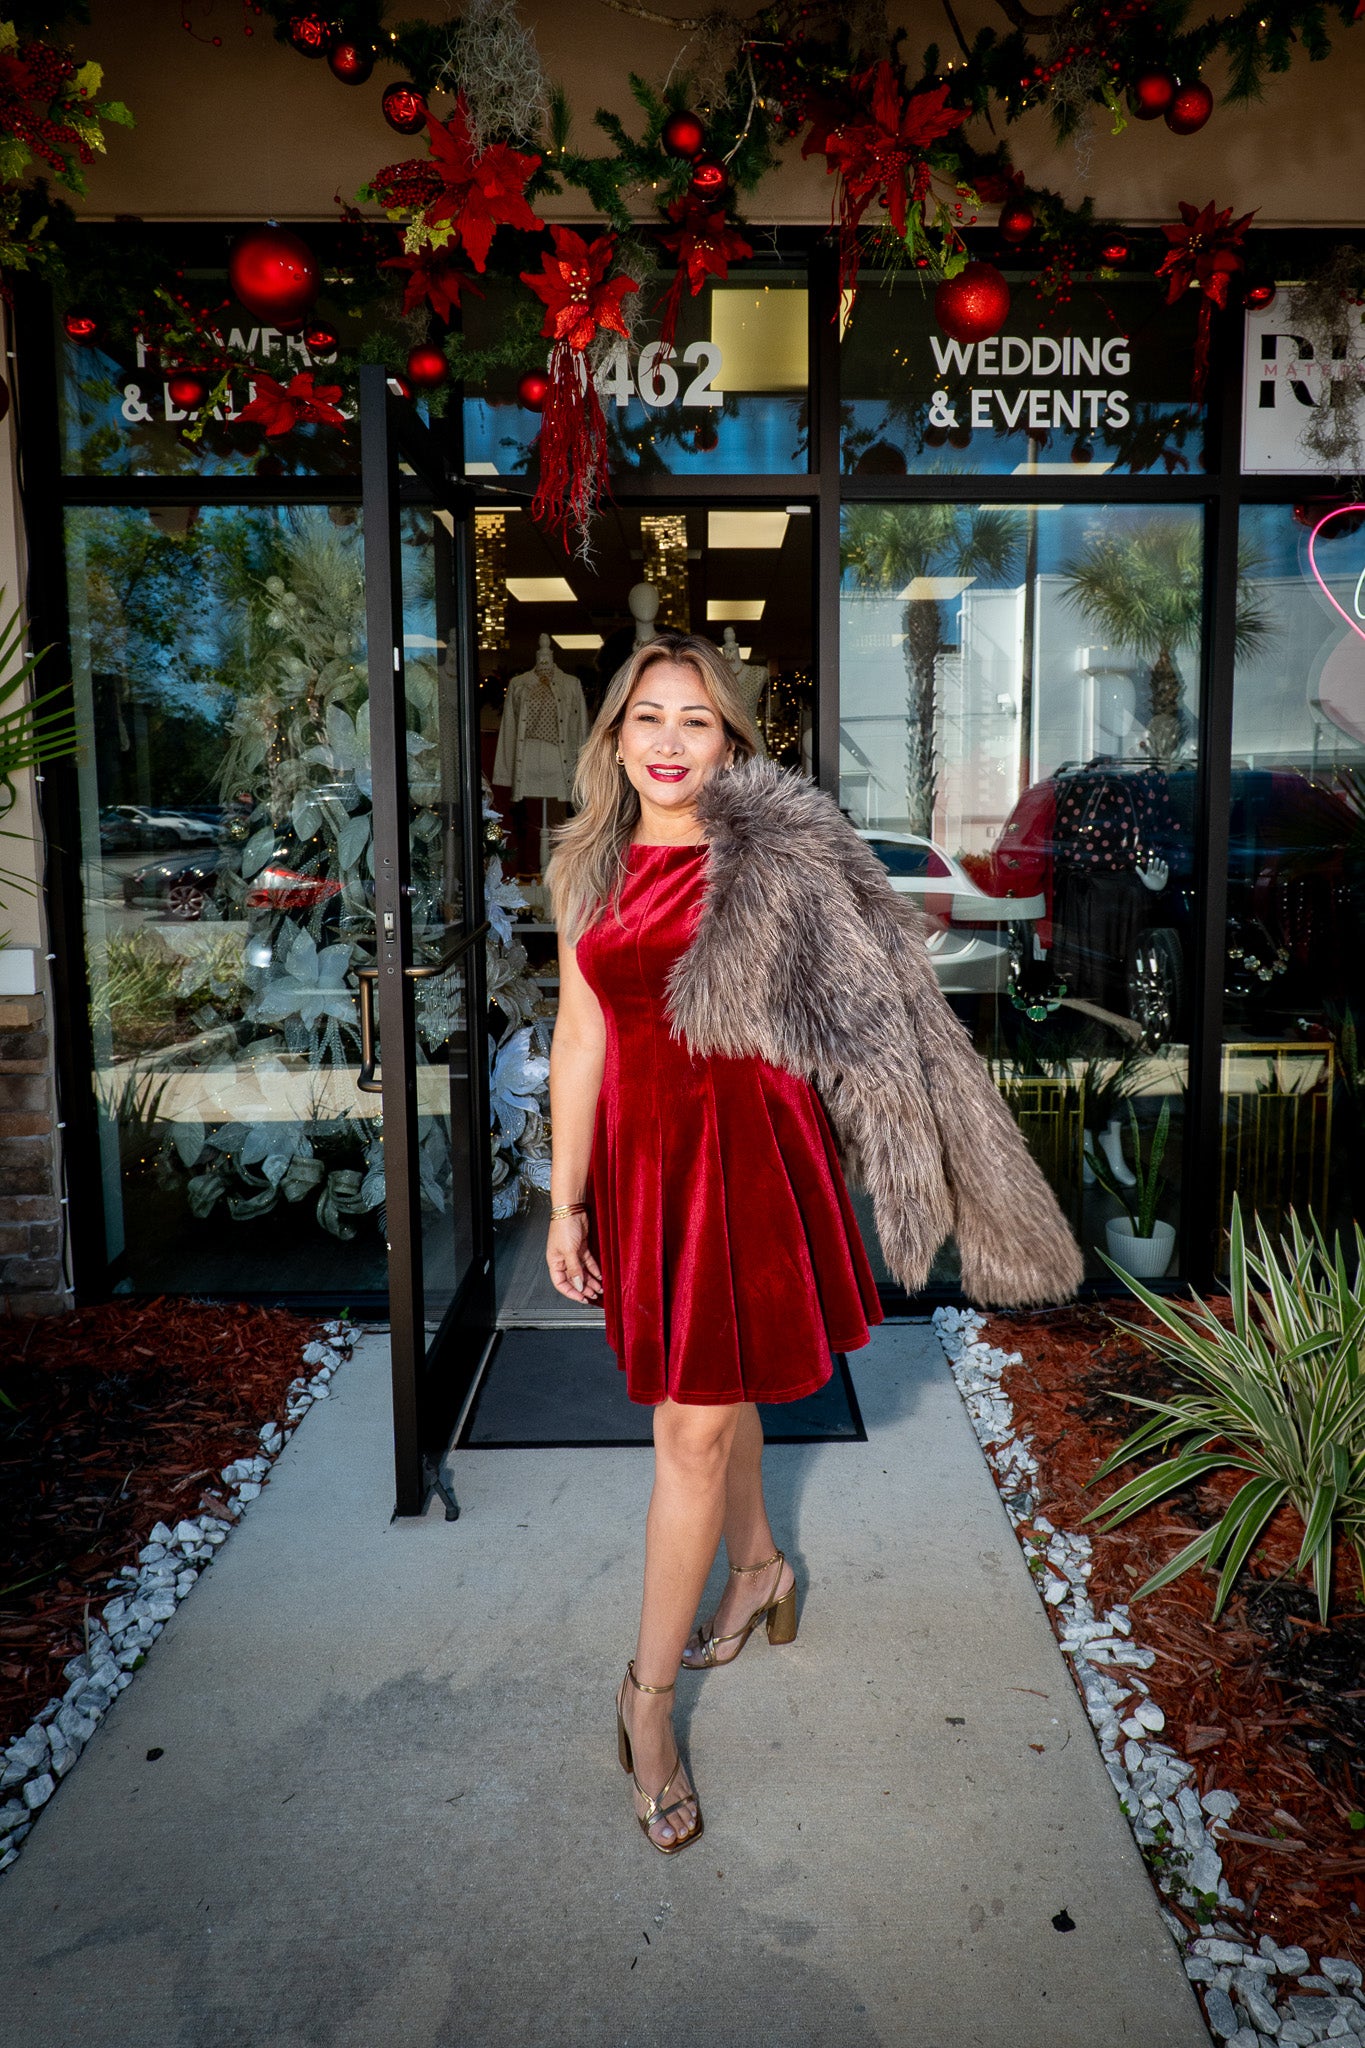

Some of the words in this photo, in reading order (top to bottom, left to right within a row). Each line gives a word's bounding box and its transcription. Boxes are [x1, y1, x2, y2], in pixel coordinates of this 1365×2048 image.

[929, 336, 1131, 376] WEDDING
[121, 383, 154, 421] &
[928, 390, 960, 428] &
[971, 389, 1131, 429] EVENTS
